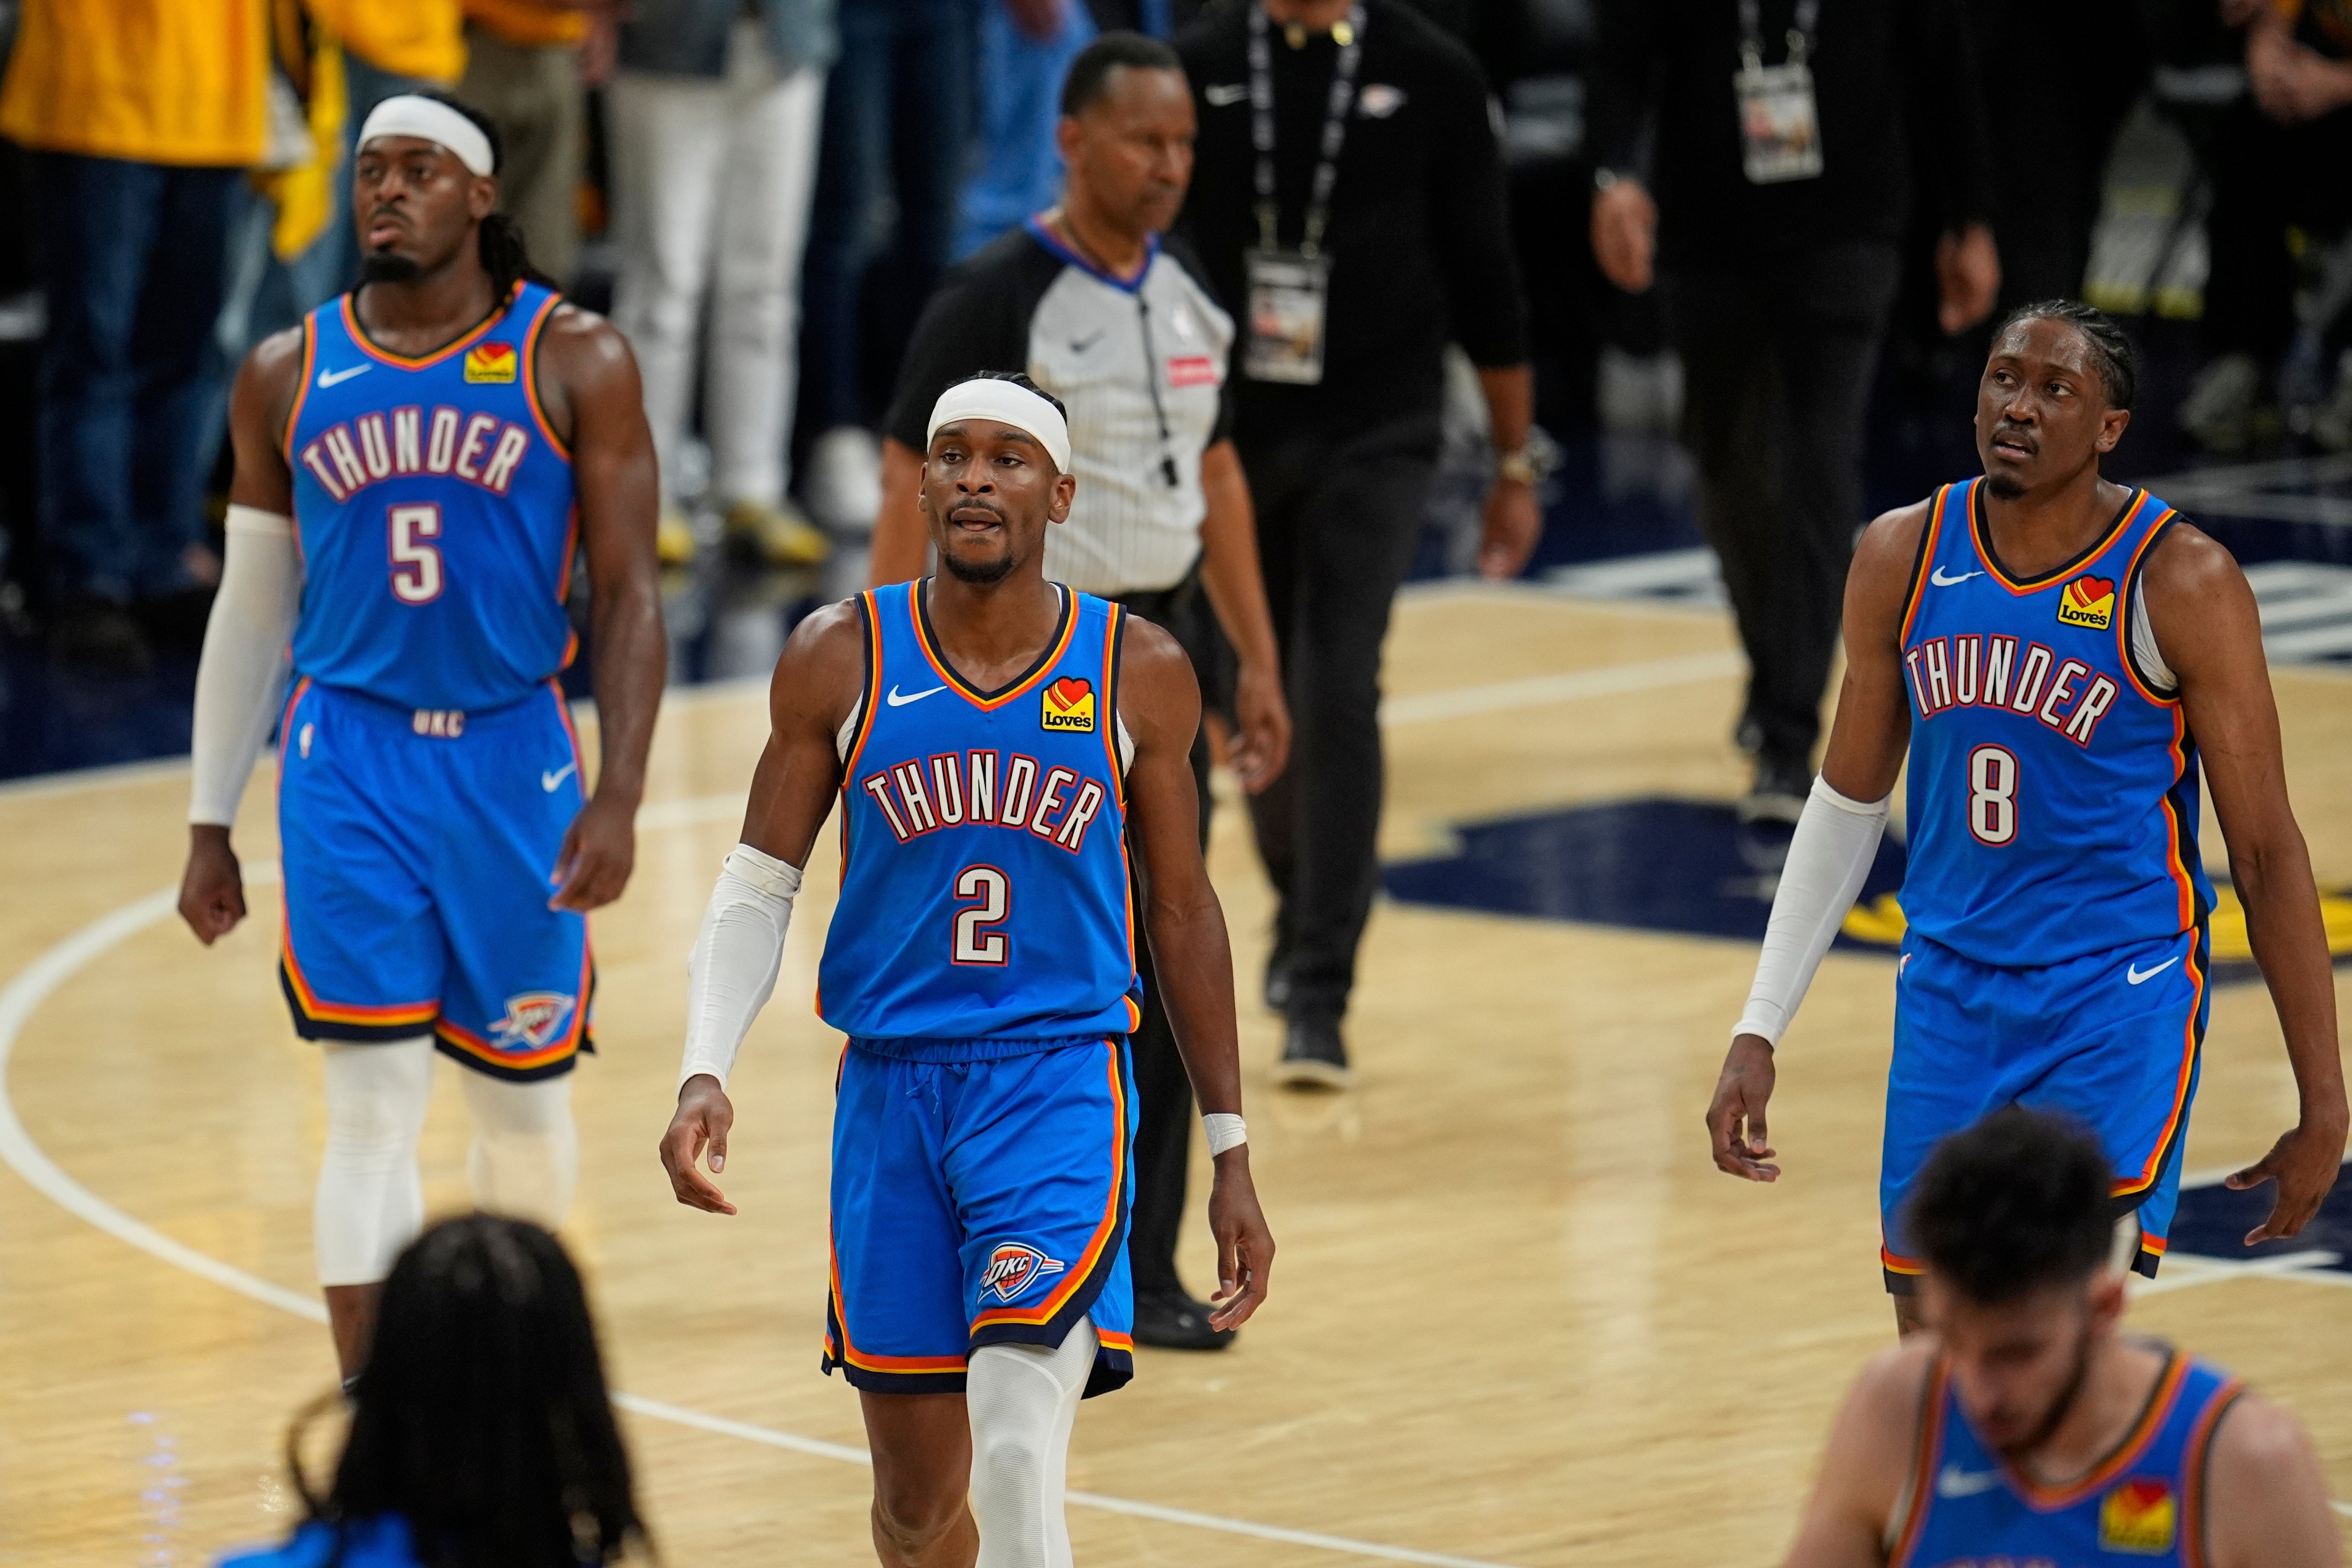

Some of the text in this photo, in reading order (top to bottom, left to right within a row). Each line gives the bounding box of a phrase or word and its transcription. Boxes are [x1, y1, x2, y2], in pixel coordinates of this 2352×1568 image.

[302, 406, 528, 502] THUNDER
[387, 502, 443, 604] 5
[1906, 634, 2119, 747] THUNDER
[865, 750, 1103, 854] THUNDER
[1969, 744, 2018, 846] 8
[951, 864, 1010, 967] 2
[983, 1256, 1030, 1288] OKC
